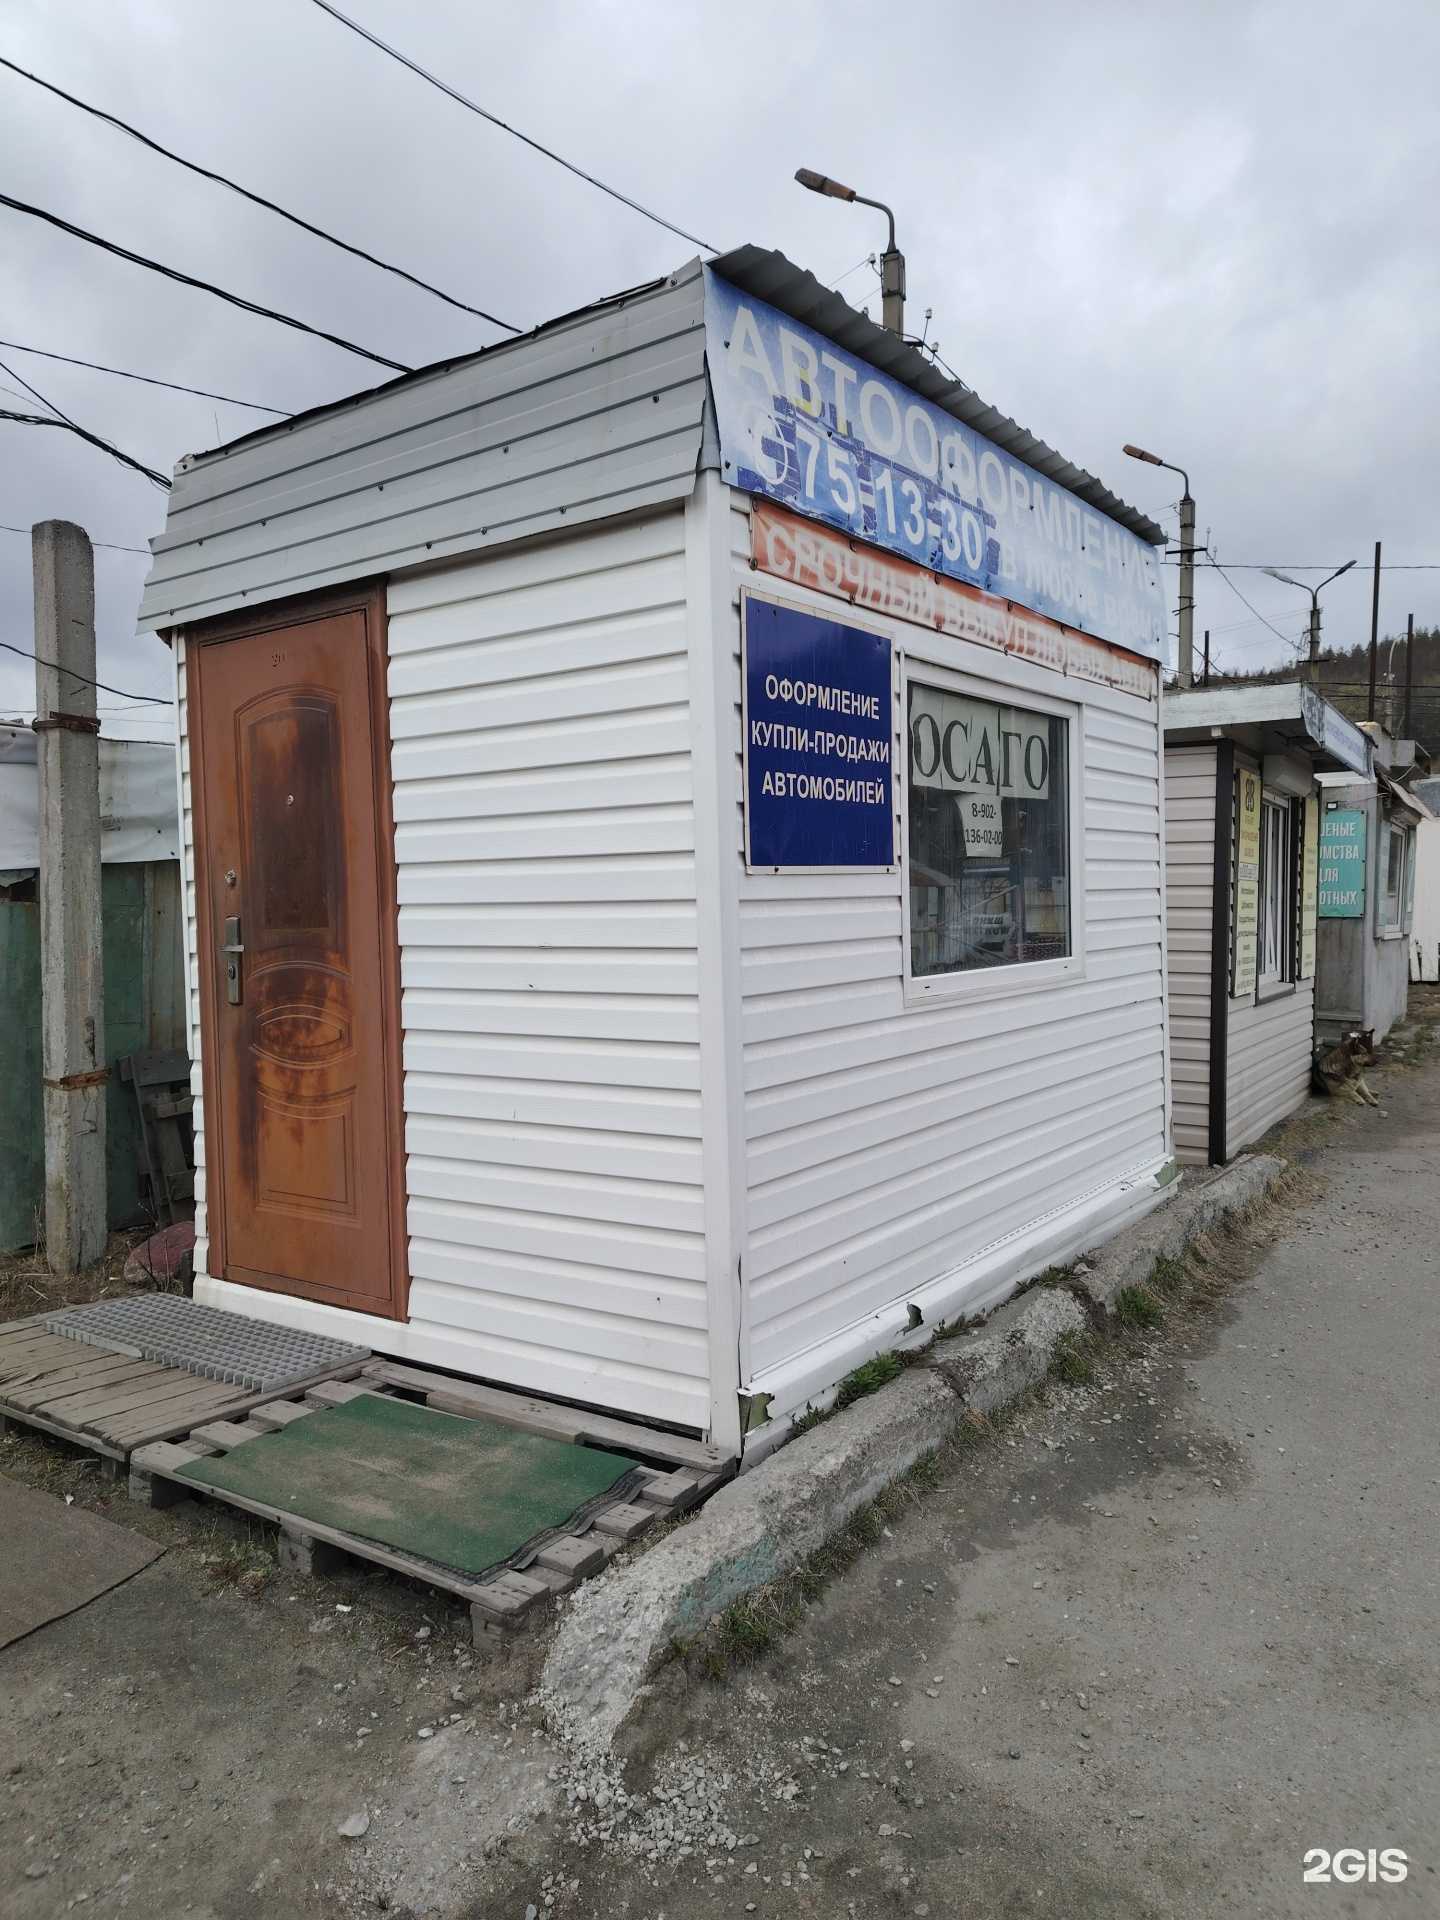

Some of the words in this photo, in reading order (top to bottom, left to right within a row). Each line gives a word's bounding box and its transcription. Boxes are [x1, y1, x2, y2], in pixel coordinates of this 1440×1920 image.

[727, 305, 1158, 592] АВТООФОРМЛЕНИЕ
[795, 428, 983, 571] 75-13-30
[764, 674, 880, 721] ОФОРМЛЕНИЕ
[751, 720, 889, 764] КУПЛИ-ПРОДАЖИ
[911, 712, 1049, 791] ОСАГО
[761, 770, 885, 805] АВТОМОБИЛЕЙ
